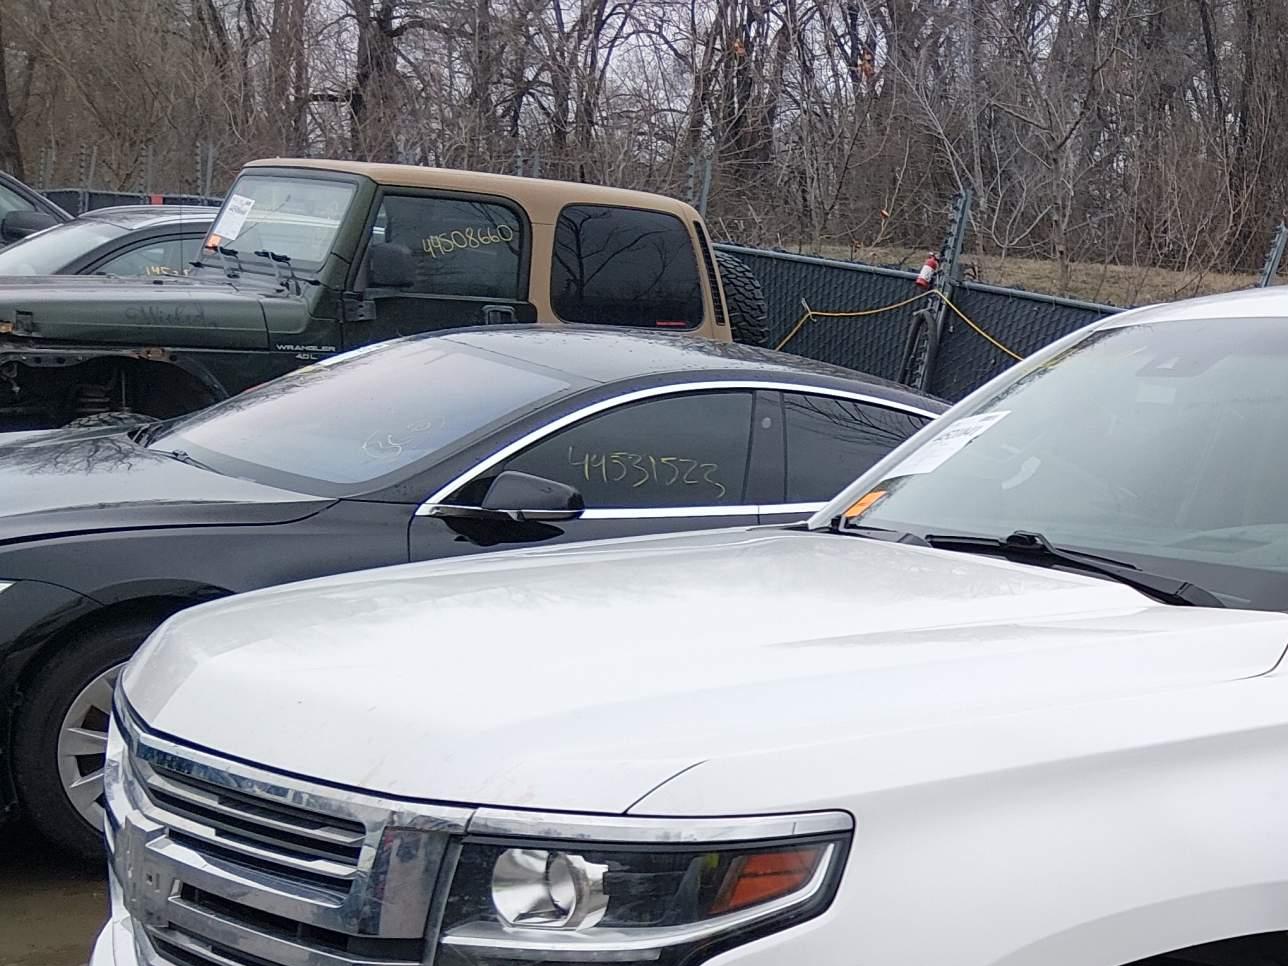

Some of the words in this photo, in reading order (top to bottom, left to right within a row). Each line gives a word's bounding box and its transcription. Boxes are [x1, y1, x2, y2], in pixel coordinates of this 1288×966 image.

[421, 224, 514, 258] 44508660
[275, 344, 336, 352] WRANGLER
[568, 445, 726, 499] 44531523
